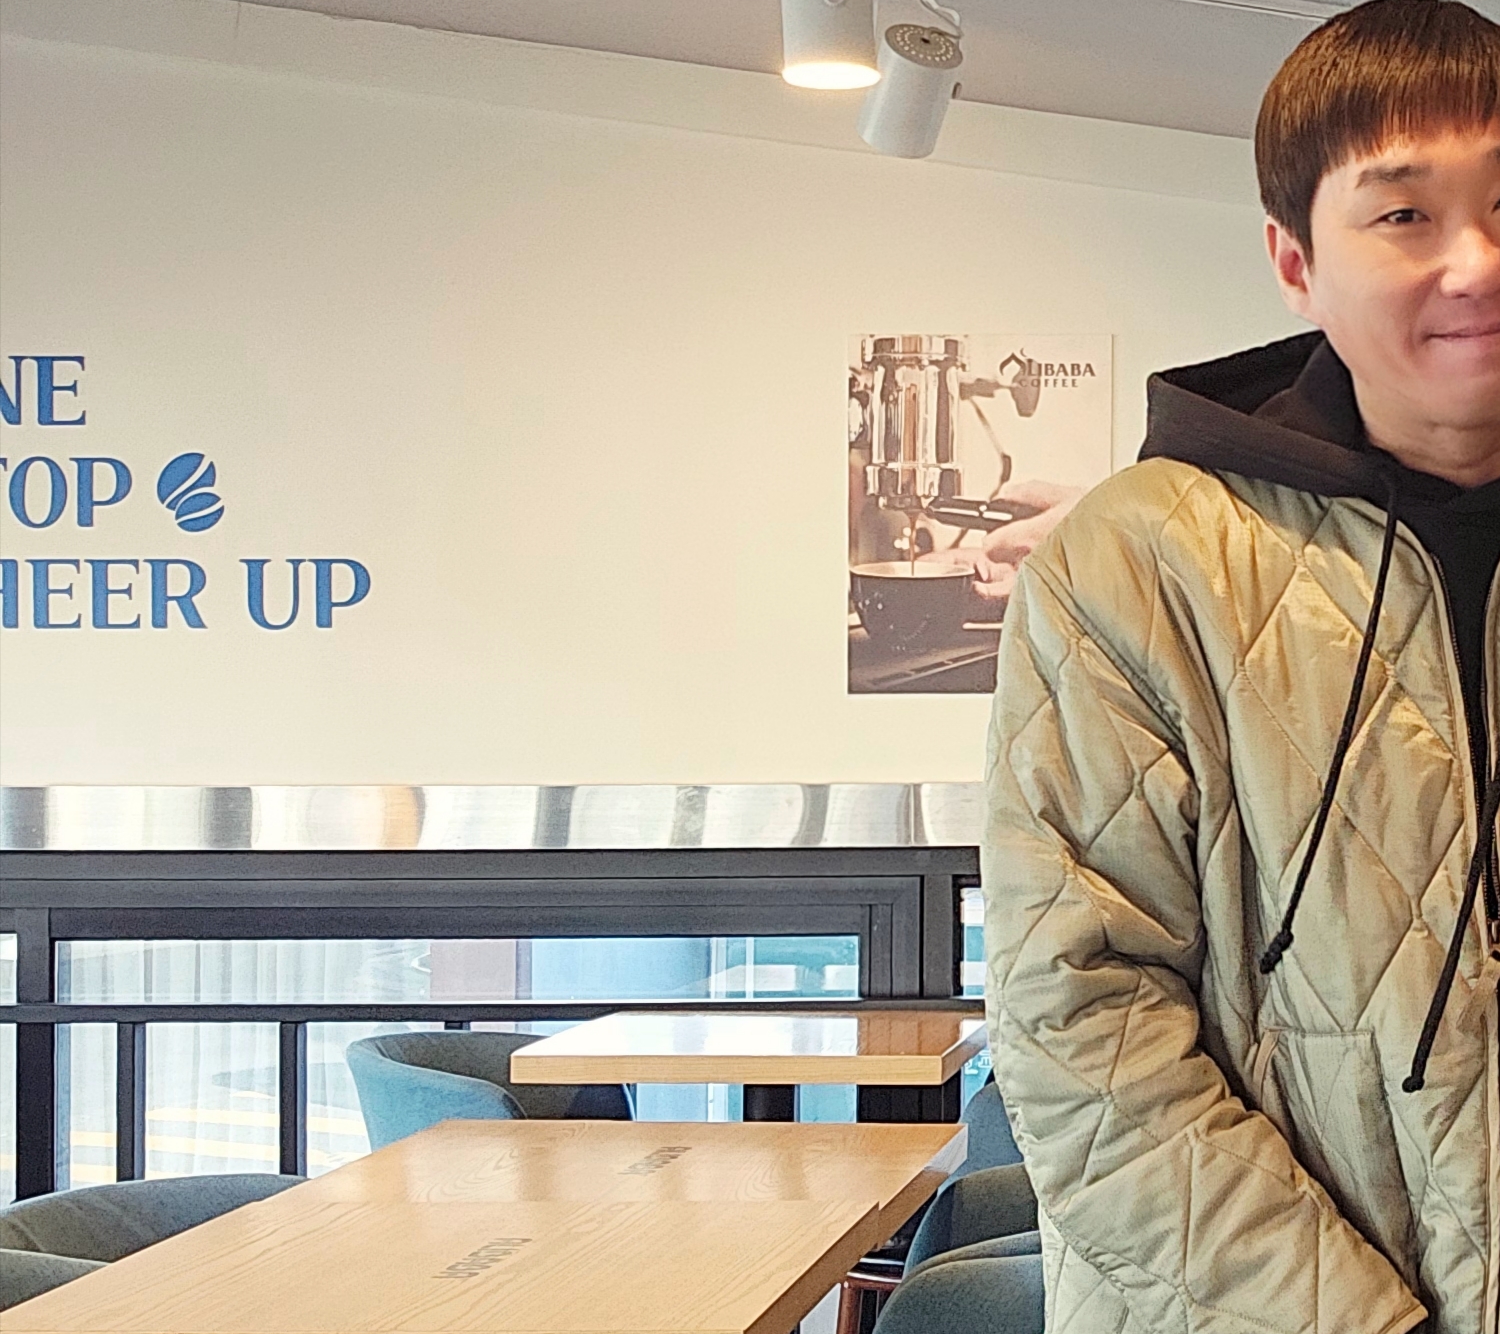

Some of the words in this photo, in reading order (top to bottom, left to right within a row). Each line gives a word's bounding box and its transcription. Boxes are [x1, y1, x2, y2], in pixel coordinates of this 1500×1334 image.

[1020, 378, 1079, 388] COFFEE
[0, 455, 133, 529] OP
[239, 558, 372, 631] UP
